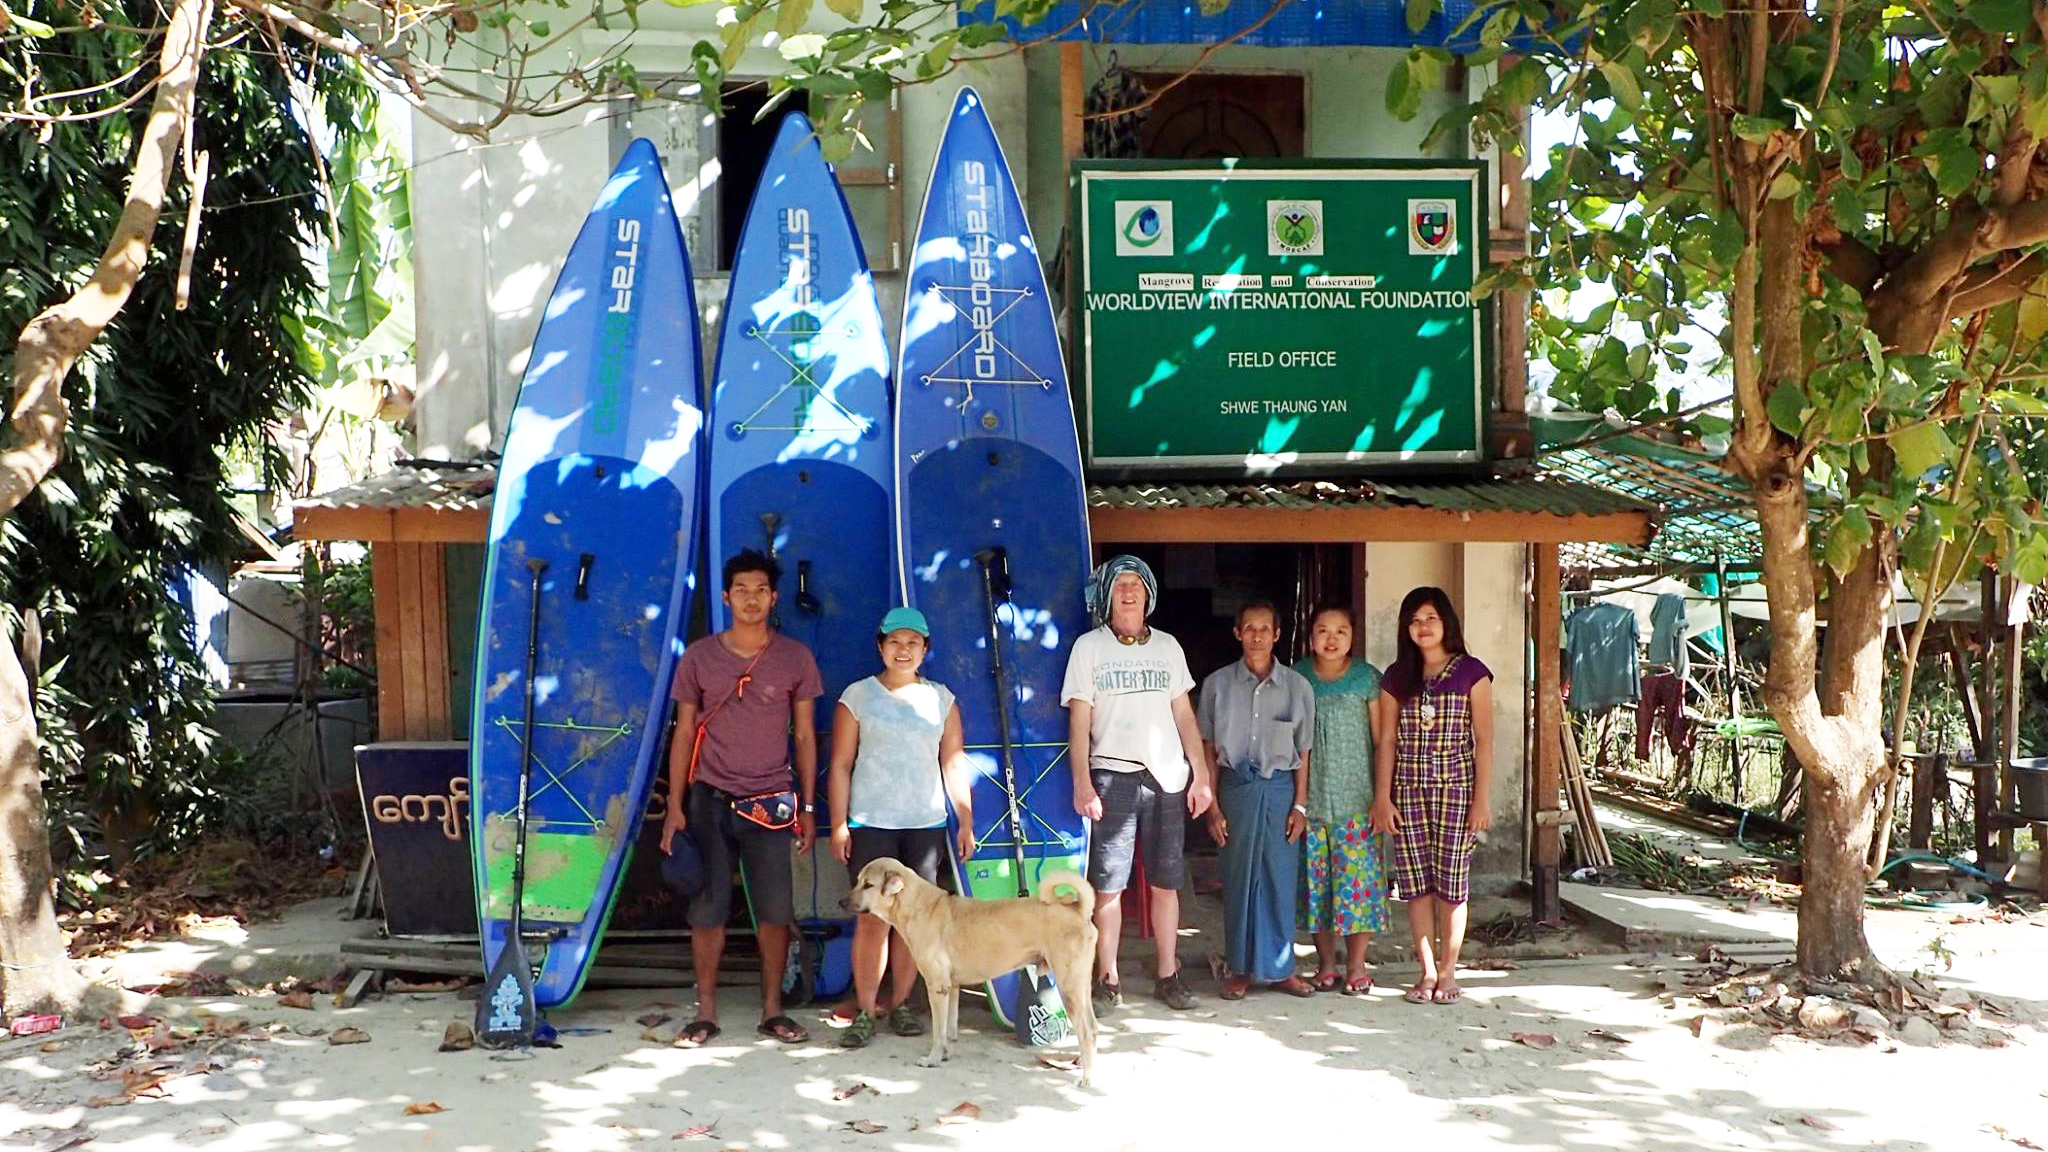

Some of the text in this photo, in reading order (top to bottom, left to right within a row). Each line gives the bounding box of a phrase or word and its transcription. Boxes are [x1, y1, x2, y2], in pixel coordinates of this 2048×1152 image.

[1141, 276, 1373, 287] Mangrove Reation and Conservation
[1087, 291, 1478, 310] WORLDVIEW INTERNATIONAL FOUNDATION
[1228, 351, 1336, 368] FIELD OFFICE
[1220, 400, 1347, 414] SHWE THAUNG YAN
